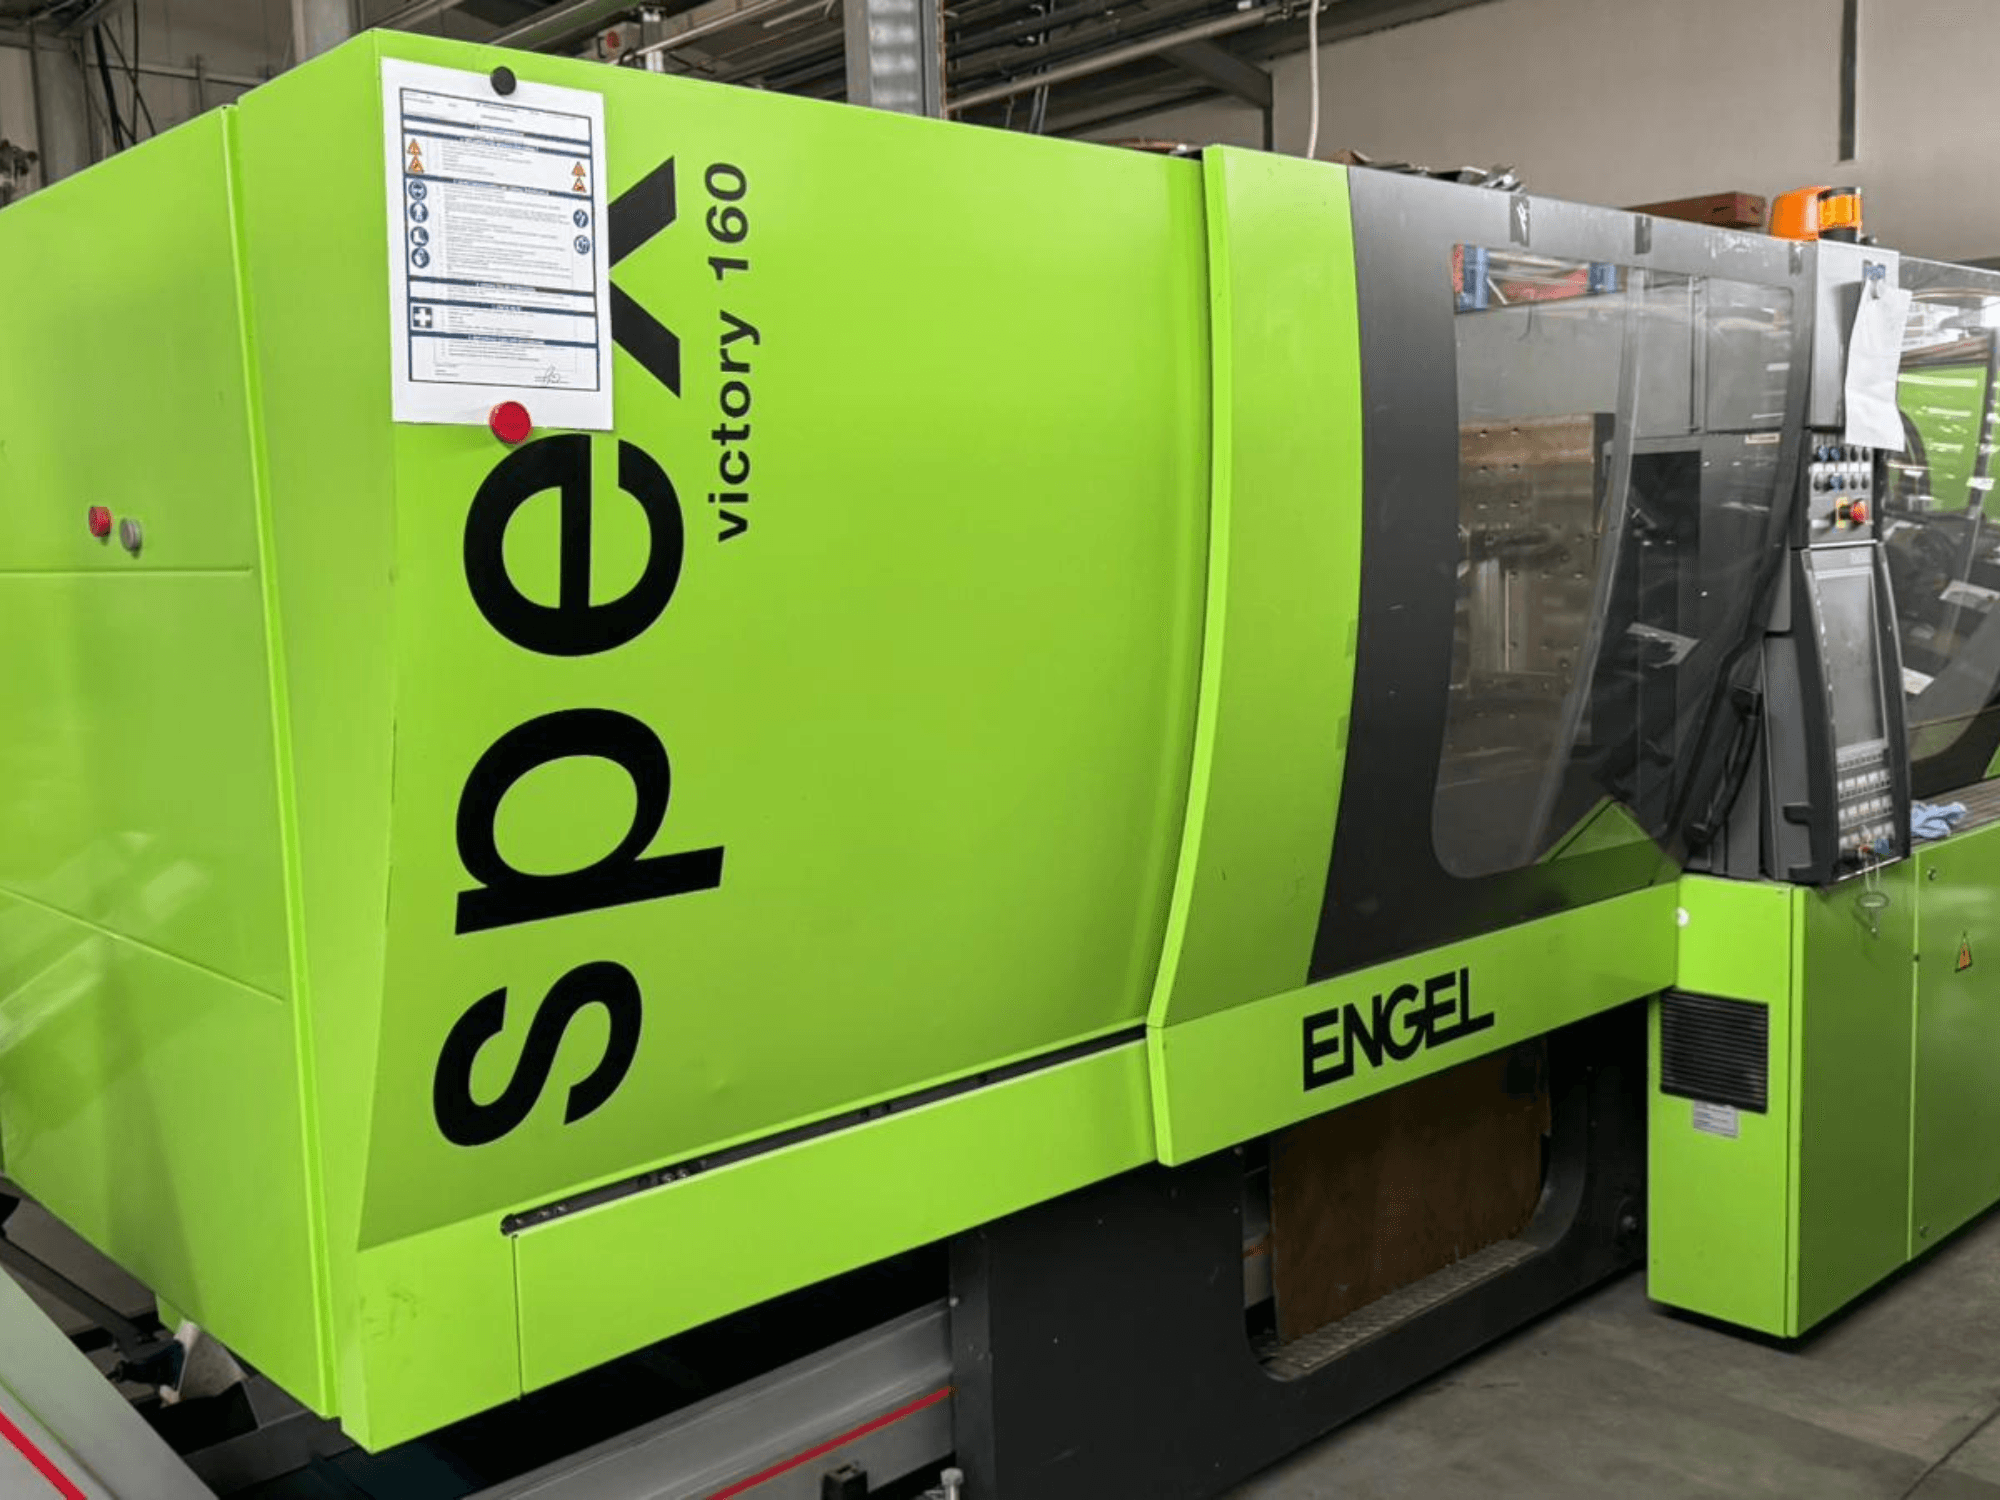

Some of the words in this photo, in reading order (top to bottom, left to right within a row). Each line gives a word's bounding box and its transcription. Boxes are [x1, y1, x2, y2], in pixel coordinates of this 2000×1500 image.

[704, 162, 749, 282] 160
[708, 310, 761, 543] victory
[1303, 966, 1495, 1092] ENGEL
